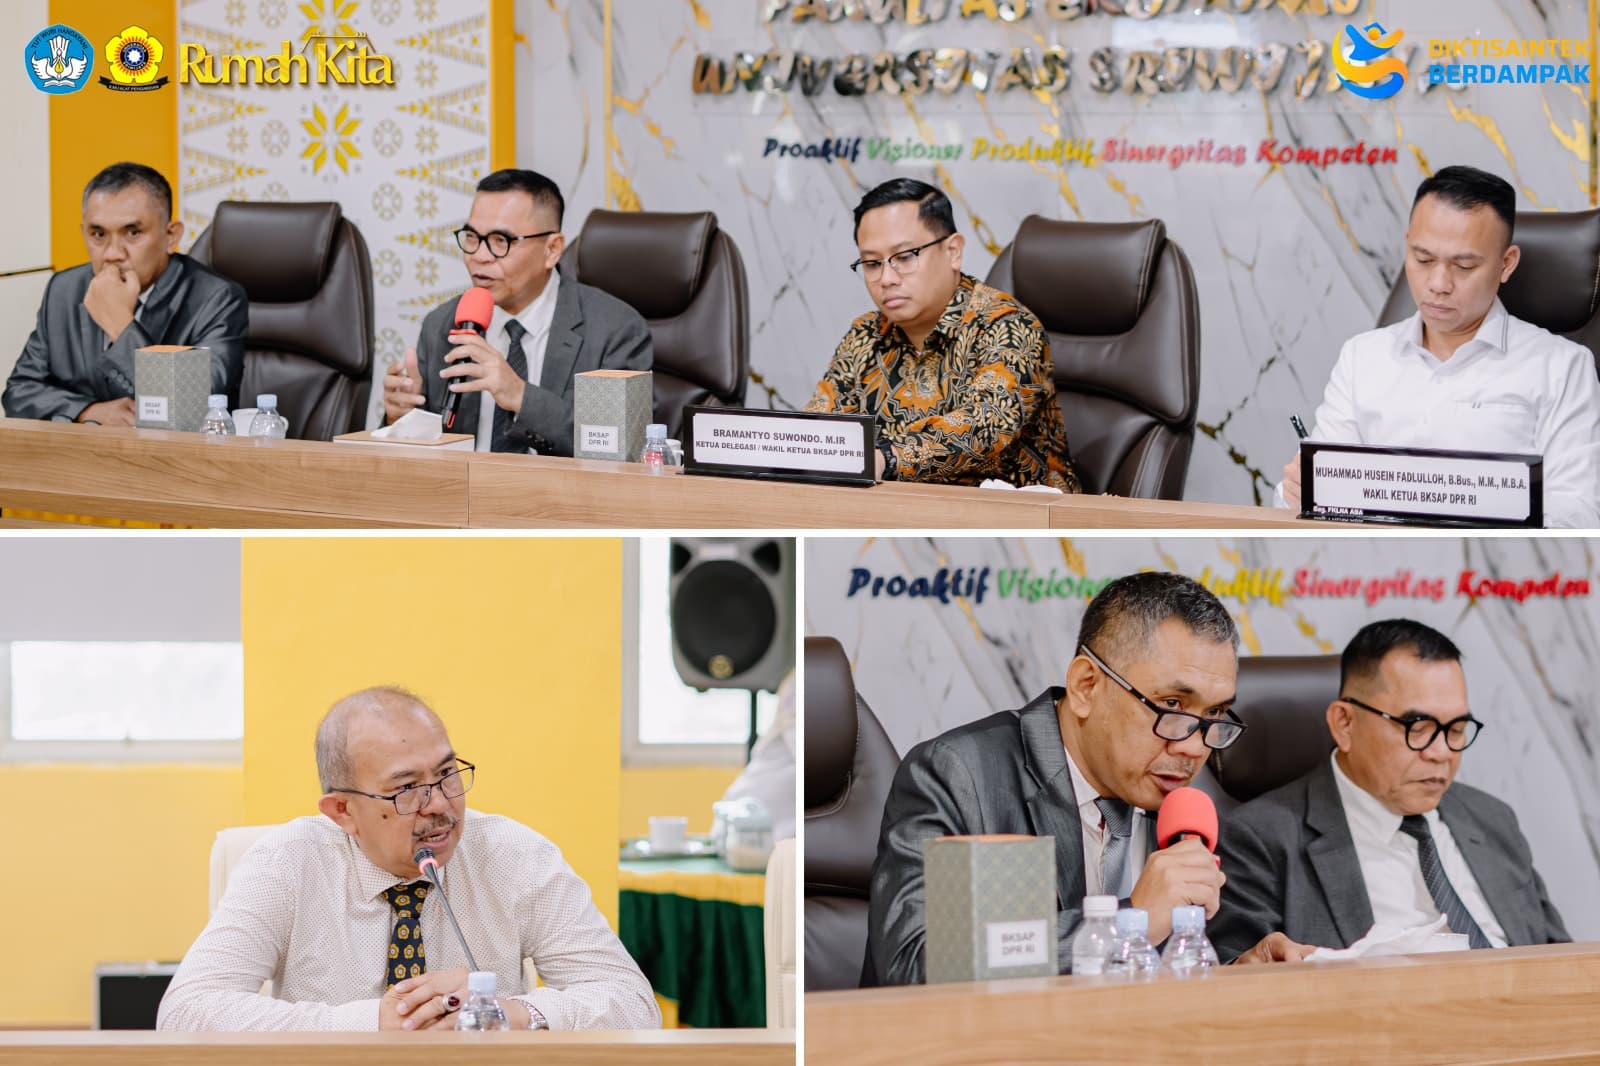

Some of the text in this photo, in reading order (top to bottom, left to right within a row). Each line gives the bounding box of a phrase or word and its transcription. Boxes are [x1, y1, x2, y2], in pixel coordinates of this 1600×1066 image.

[762, 137, 862, 164] Proaktif
[1255, 138, 1398, 170] Kompeten
[713, 428, 846, 445] BRAMANTYO SUWONDO. M.IR
[695, 440, 720, 449] KETUA
[721, 442, 757, 451] DELEGASI
[761, 444, 785, 453] WAKIL
[786, 446, 812, 455] KETUA
[813, 447, 838, 456] BKSAP
[839, 449, 855, 457] DPR
[1315, 466, 1527, 490] MUHAMMAD HUSEIN FADLULLOH, B.Bus., M.M., M.B.A.
[1363, 487, 1477, 506] WAKIL KETUA BKSAP DPR RI
[848, 567, 990, 604] Proaktif
[997, 567, 1113, 602] Vision
[1455, 569, 1589, 604] Kompeten
